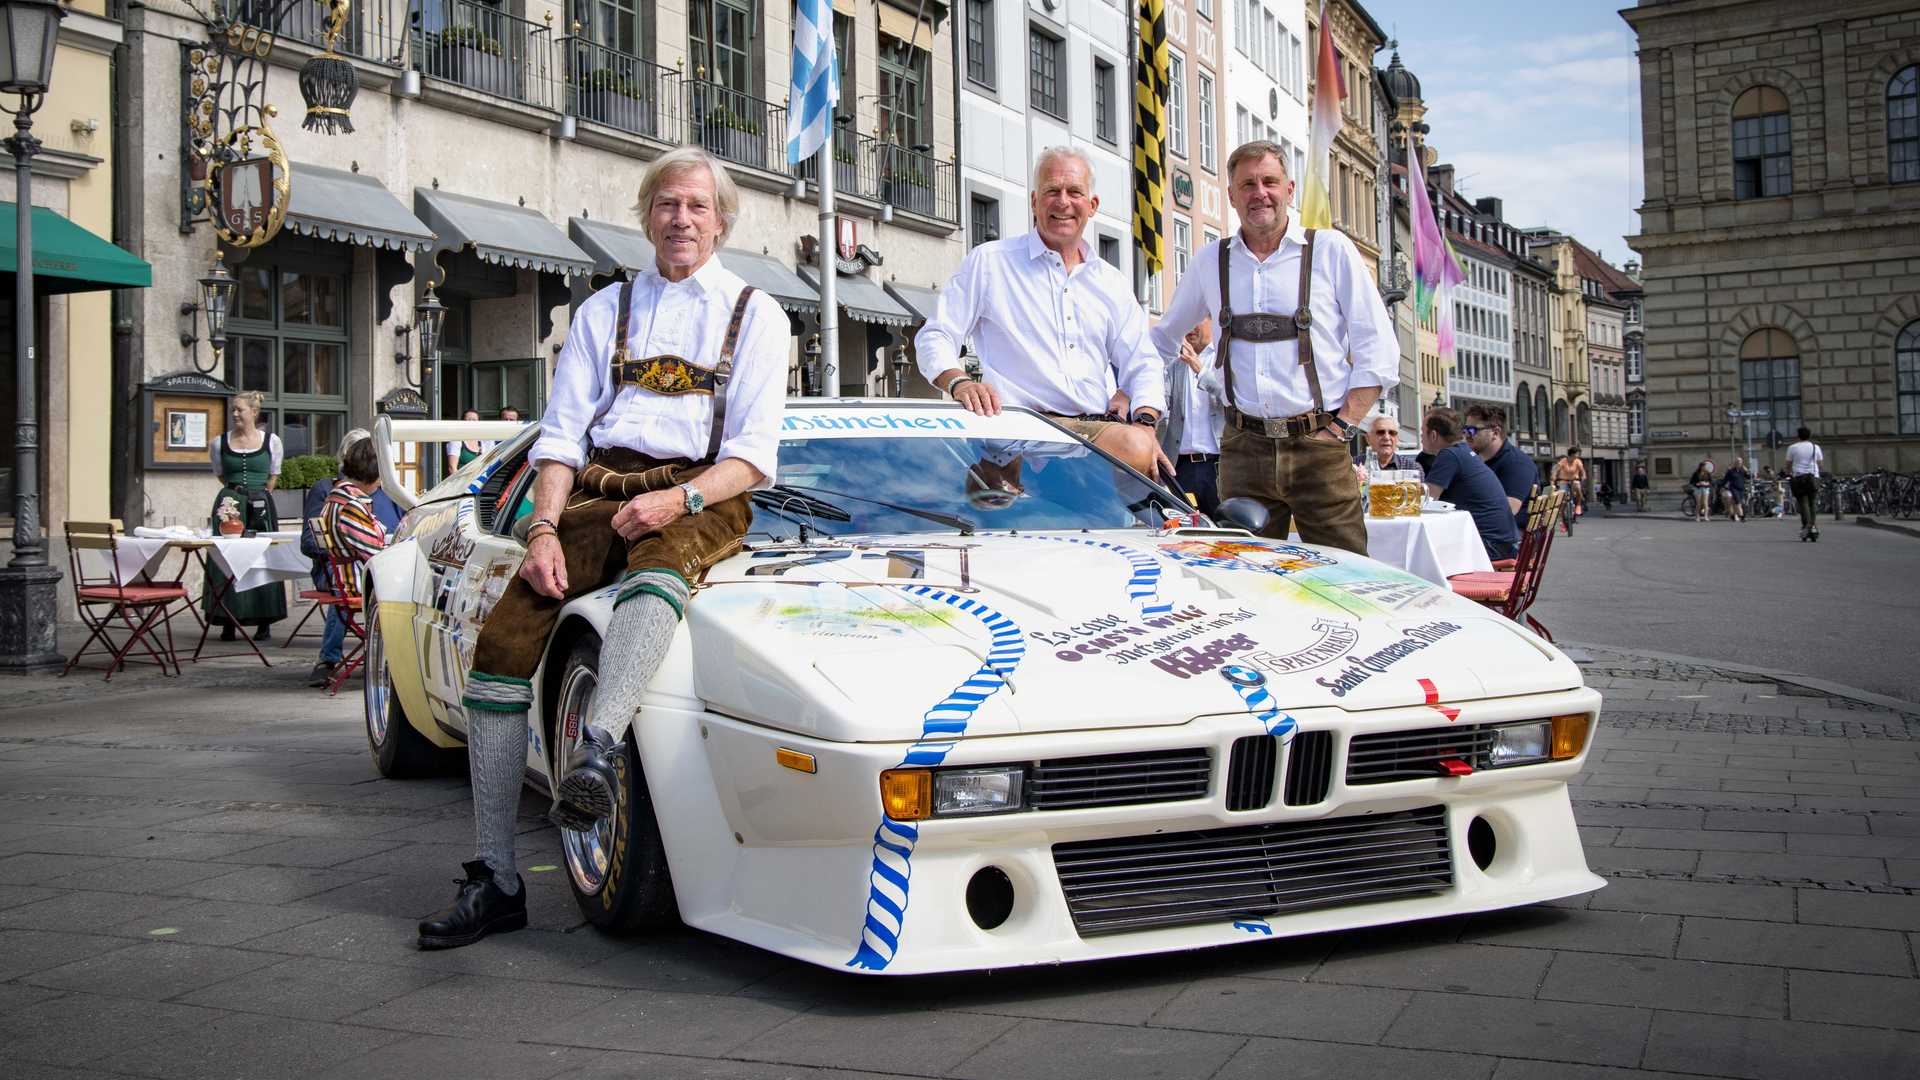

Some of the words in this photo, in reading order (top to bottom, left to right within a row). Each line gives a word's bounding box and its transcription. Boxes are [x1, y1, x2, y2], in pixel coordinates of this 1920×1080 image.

[167, 378, 217, 389] SPATENHAUS
[1269, 628, 1355, 671] SPATENHAUS
[1315, 666, 1372, 697] Sankt
